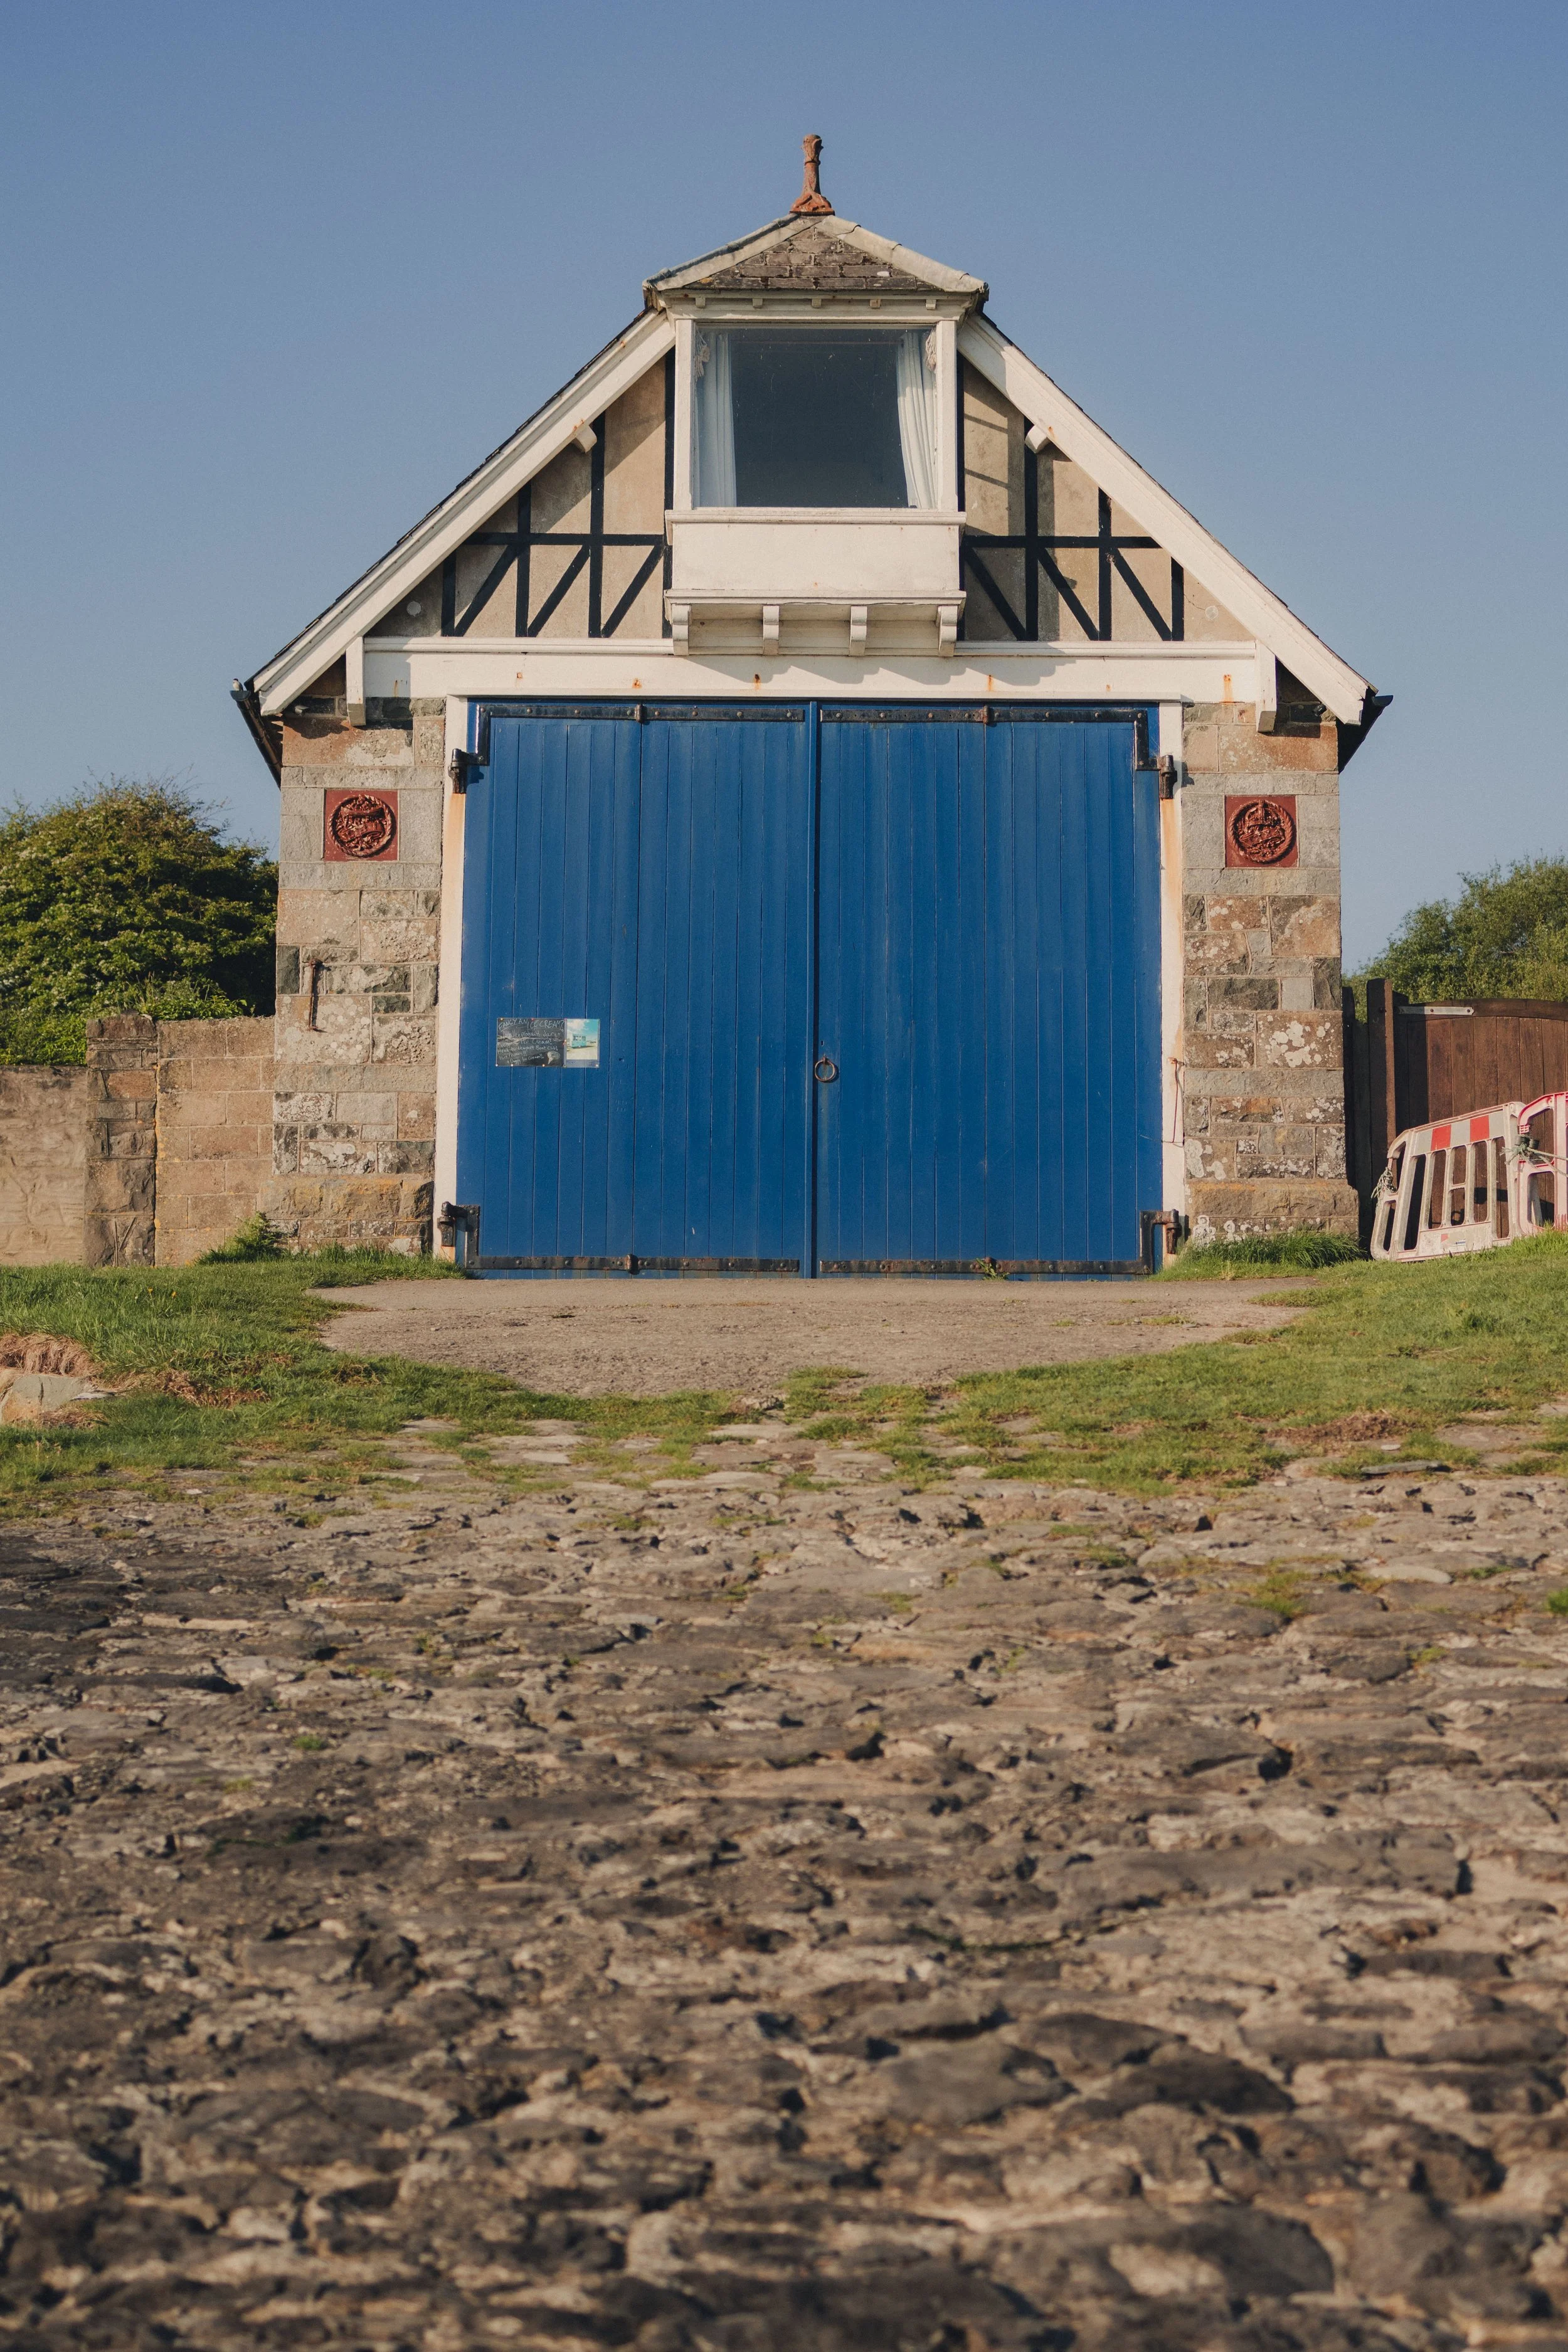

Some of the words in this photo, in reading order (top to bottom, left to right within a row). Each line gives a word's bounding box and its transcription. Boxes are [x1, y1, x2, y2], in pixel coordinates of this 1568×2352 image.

[499, 1019, 517, 1030] FANCY
[526, 1020, 539, 1030] ICE
[539, 1020, 564, 1032] CREAM?
